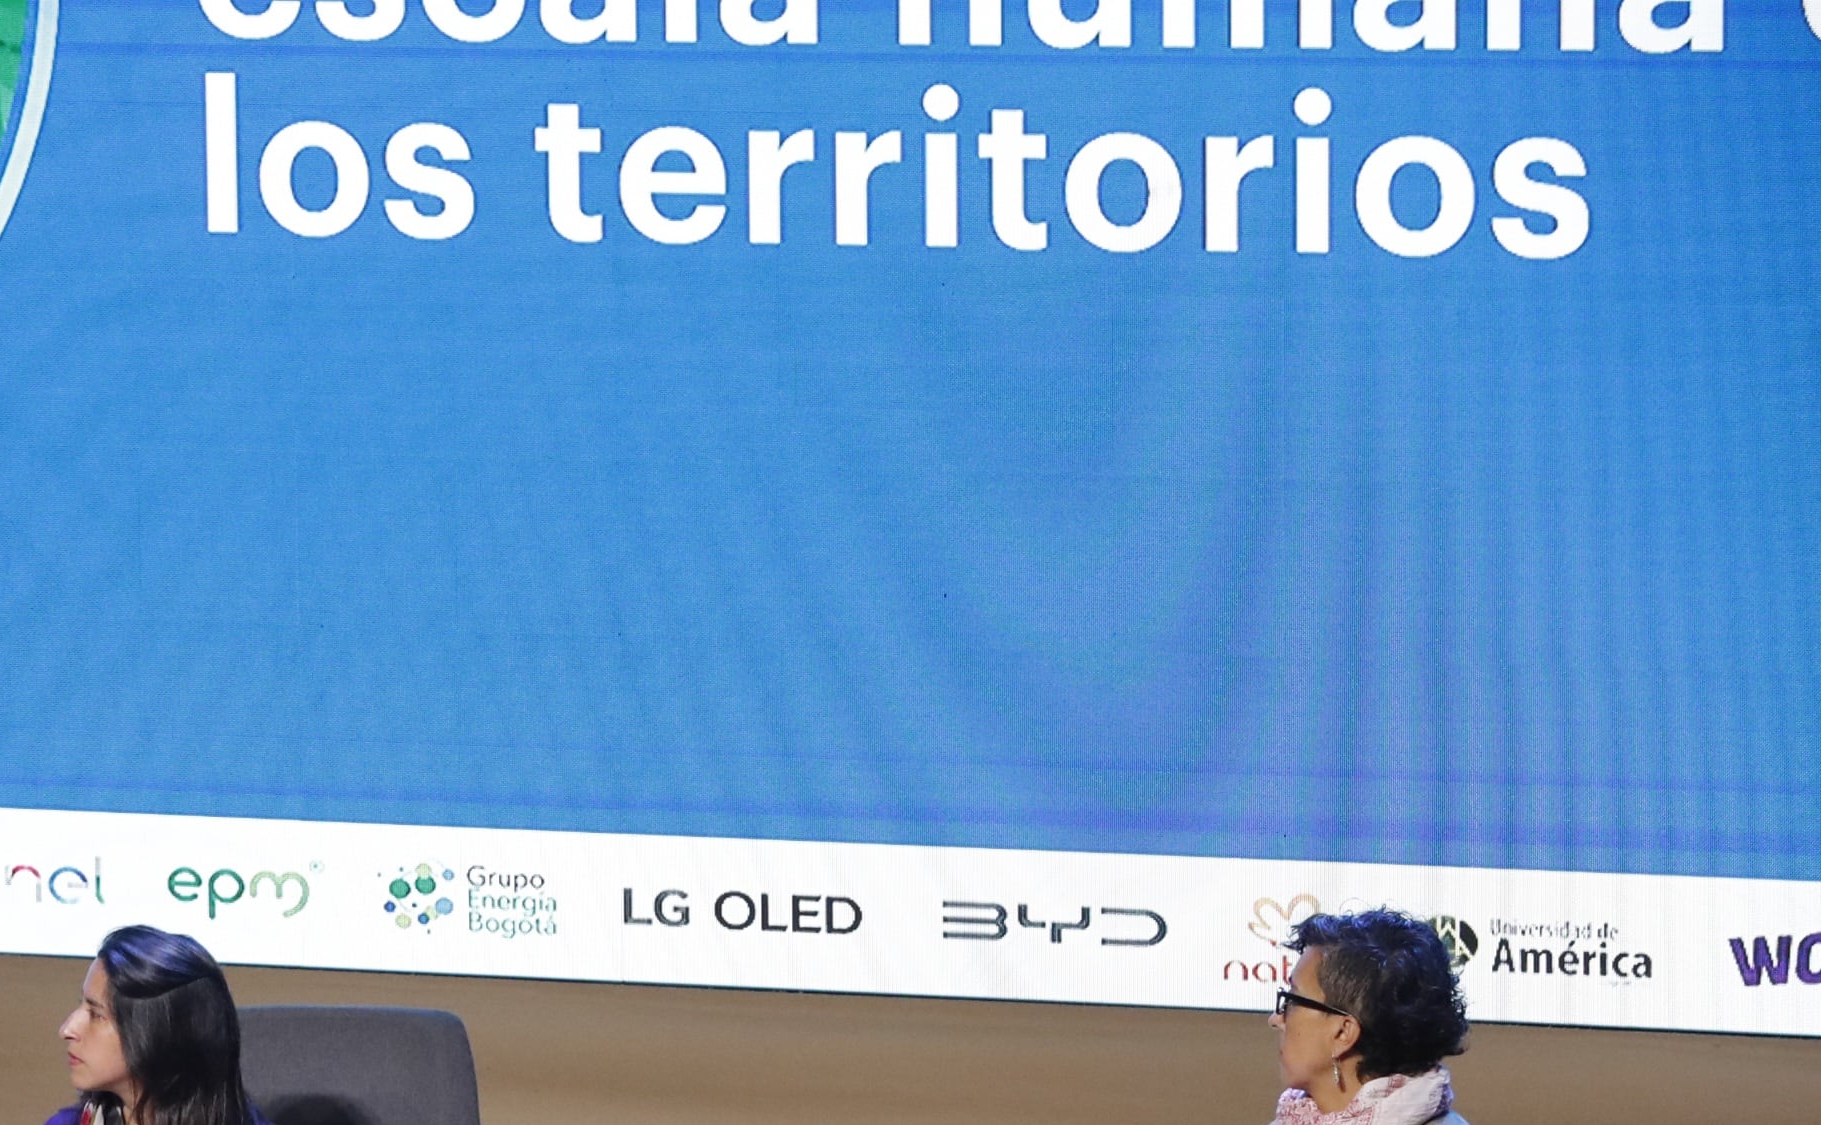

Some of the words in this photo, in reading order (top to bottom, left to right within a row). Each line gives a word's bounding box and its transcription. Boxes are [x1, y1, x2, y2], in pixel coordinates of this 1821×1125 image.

[206, 73, 474, 240] los
[535, 85, 1589, 259] territorios
[167, 867, 310, 921] epm
[467, 865, 546, 892] Grupo
[623, 888, 690, 927] LG
[714, 891, 863, 935] OLED
[942, 900, 1168, 947] BYD
[1490, 918, 1592, 940] Universidad
[1596, 922, 1619, 941] de
[1491, 940, 1652, 979] América
